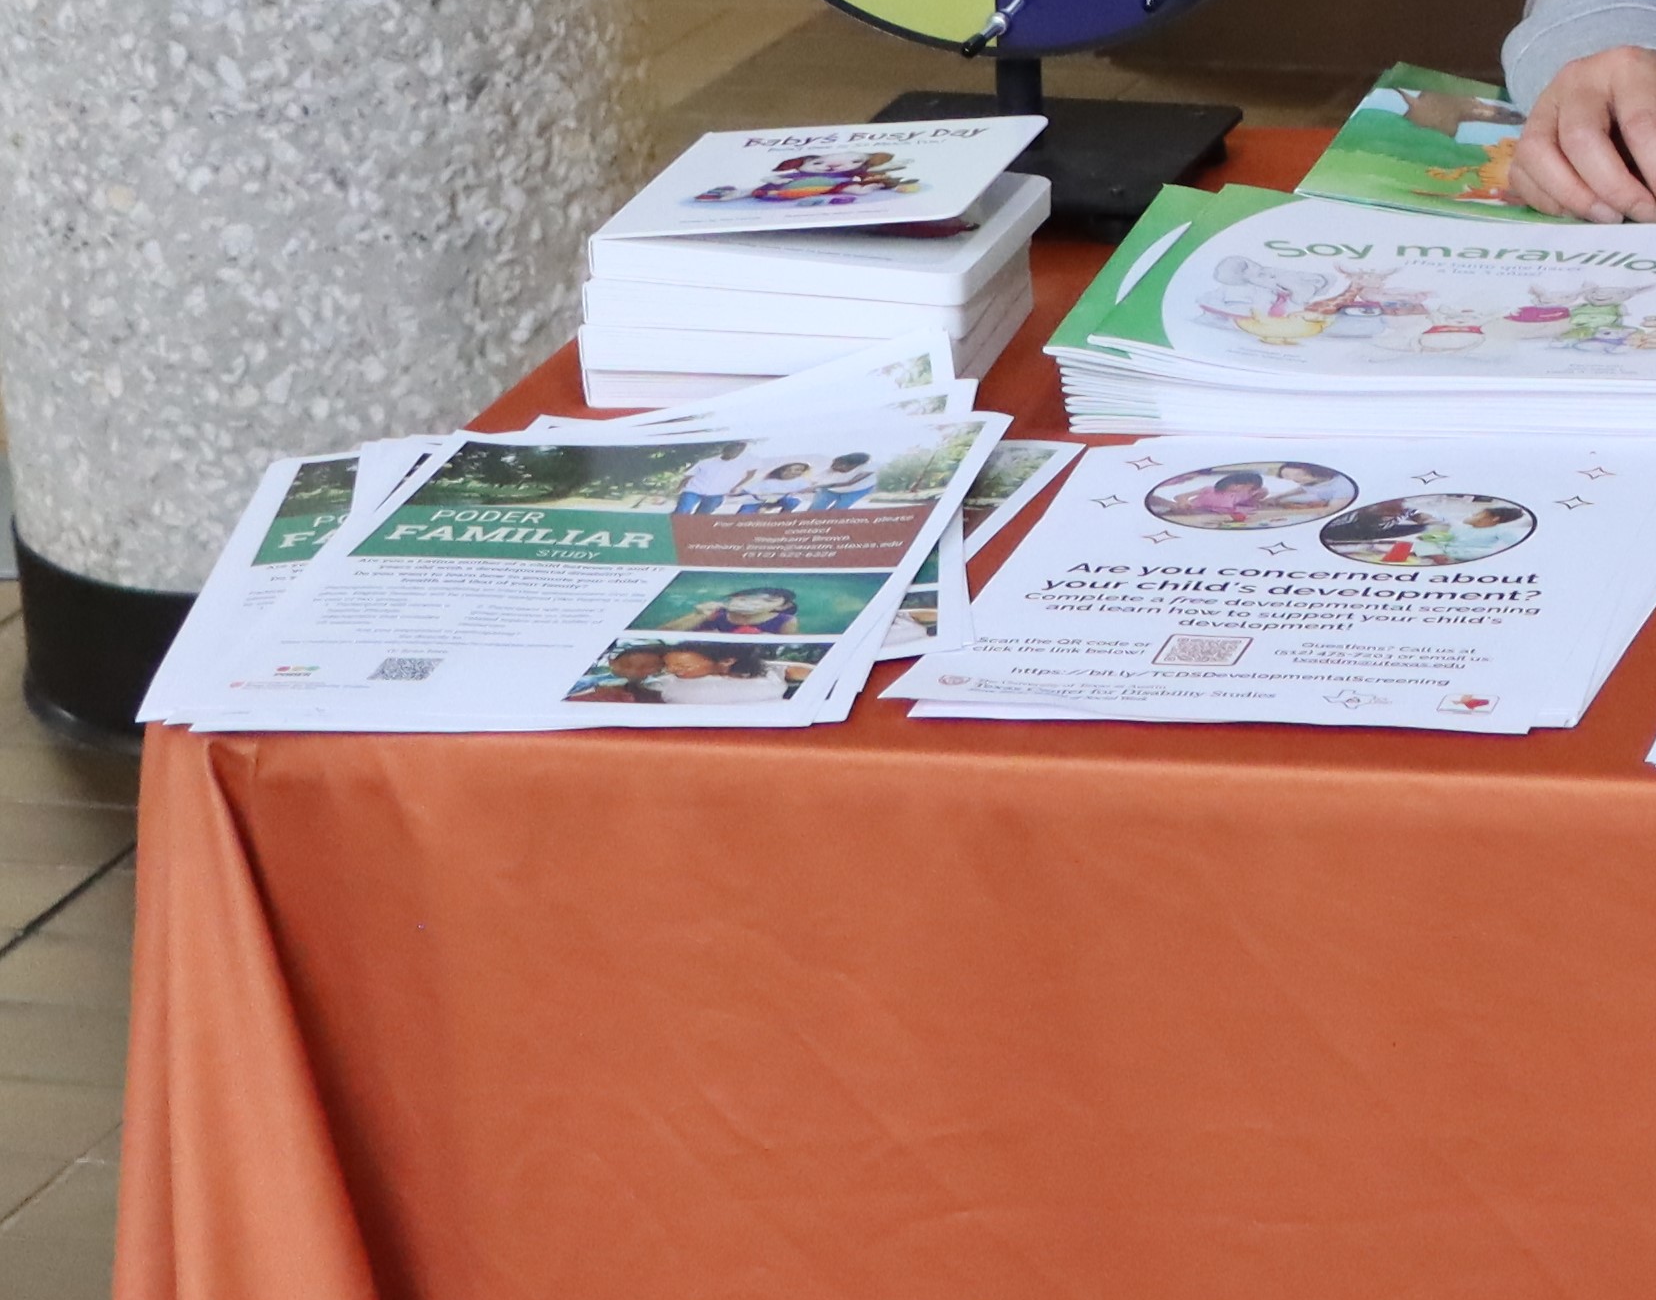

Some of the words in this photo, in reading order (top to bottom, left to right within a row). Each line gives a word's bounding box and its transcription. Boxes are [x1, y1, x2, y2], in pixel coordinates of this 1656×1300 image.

[745, 133, 839, 147] Baby's
[849, 132, 927, 141] Busy
[931, 127, 988, 138] Day
[1264, 240, 1373, 259] Soy
[432, 510, 546, 522] PODER
[384, 525, 654, 548] FAMILIAR
[536, 550, 600, 560] STUDY
[1068, 563, 1130, 573] Are
[1137, 565, 1206, 576] you
[1218, 567, 1420, 582] concerned
[1428, 572, 1540, 584] about
[1042, 580, 1129, 591] your
[1137, 581, 1257, 593] child's
[1268, 585, 1542, 601] development?
[1025, 593, 1143, 603] Complete
[1168, 596, 1218, 606] free
[1224, 598, 1412, 612] developmental
[1419, 605, 1541, 615] screening
[1099, 604, 1161, 614] learn
[1168, 607, 1219, 616] how
[1227, 610, 1252, 618] to
[1258, 611, 1354, 621] support
[1360, 614, 1417, 623] your
[1424, 615, 1503, 624] child's
[1178, 619, 1353, 630] development!
